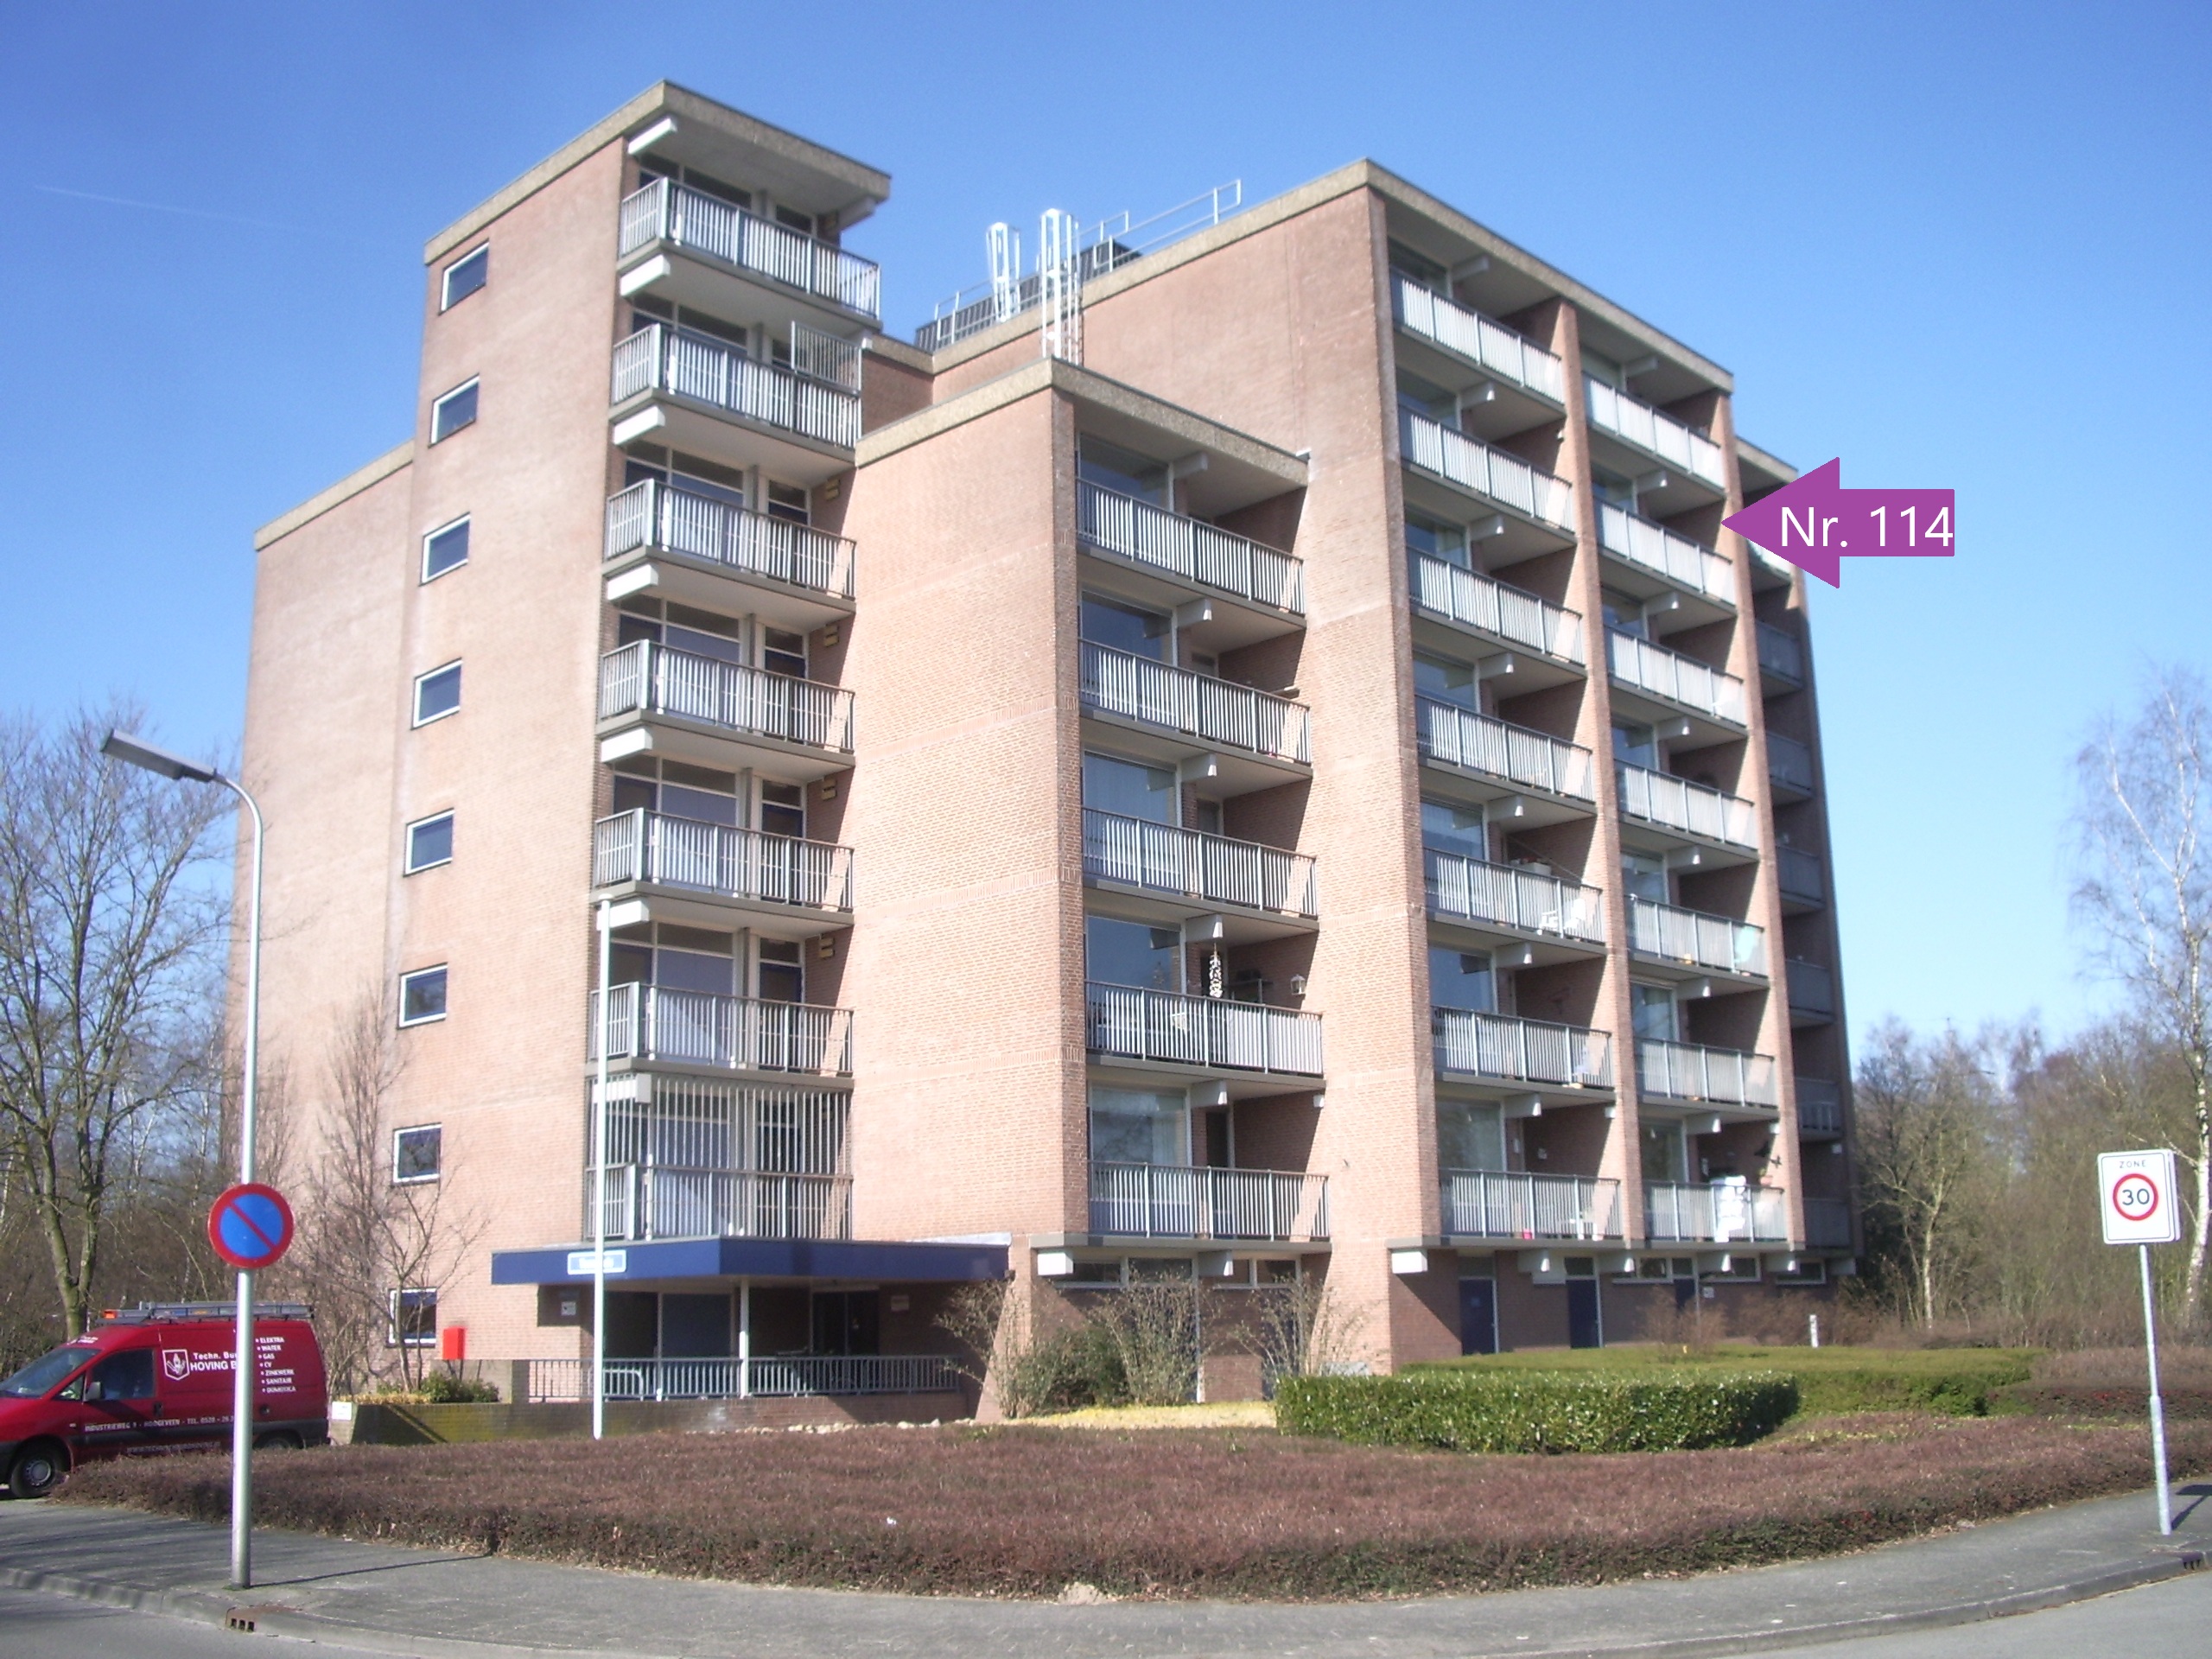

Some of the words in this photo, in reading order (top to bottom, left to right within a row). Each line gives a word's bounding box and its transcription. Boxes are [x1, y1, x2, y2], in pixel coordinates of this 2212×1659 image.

[2120, 1160, 2147, 1168] ZONE
[2122, 1188, 2150, 1206] 30
[193, 1351, 221, 1360] Techn.
[190, 1361, 229, 1371] HOVING
